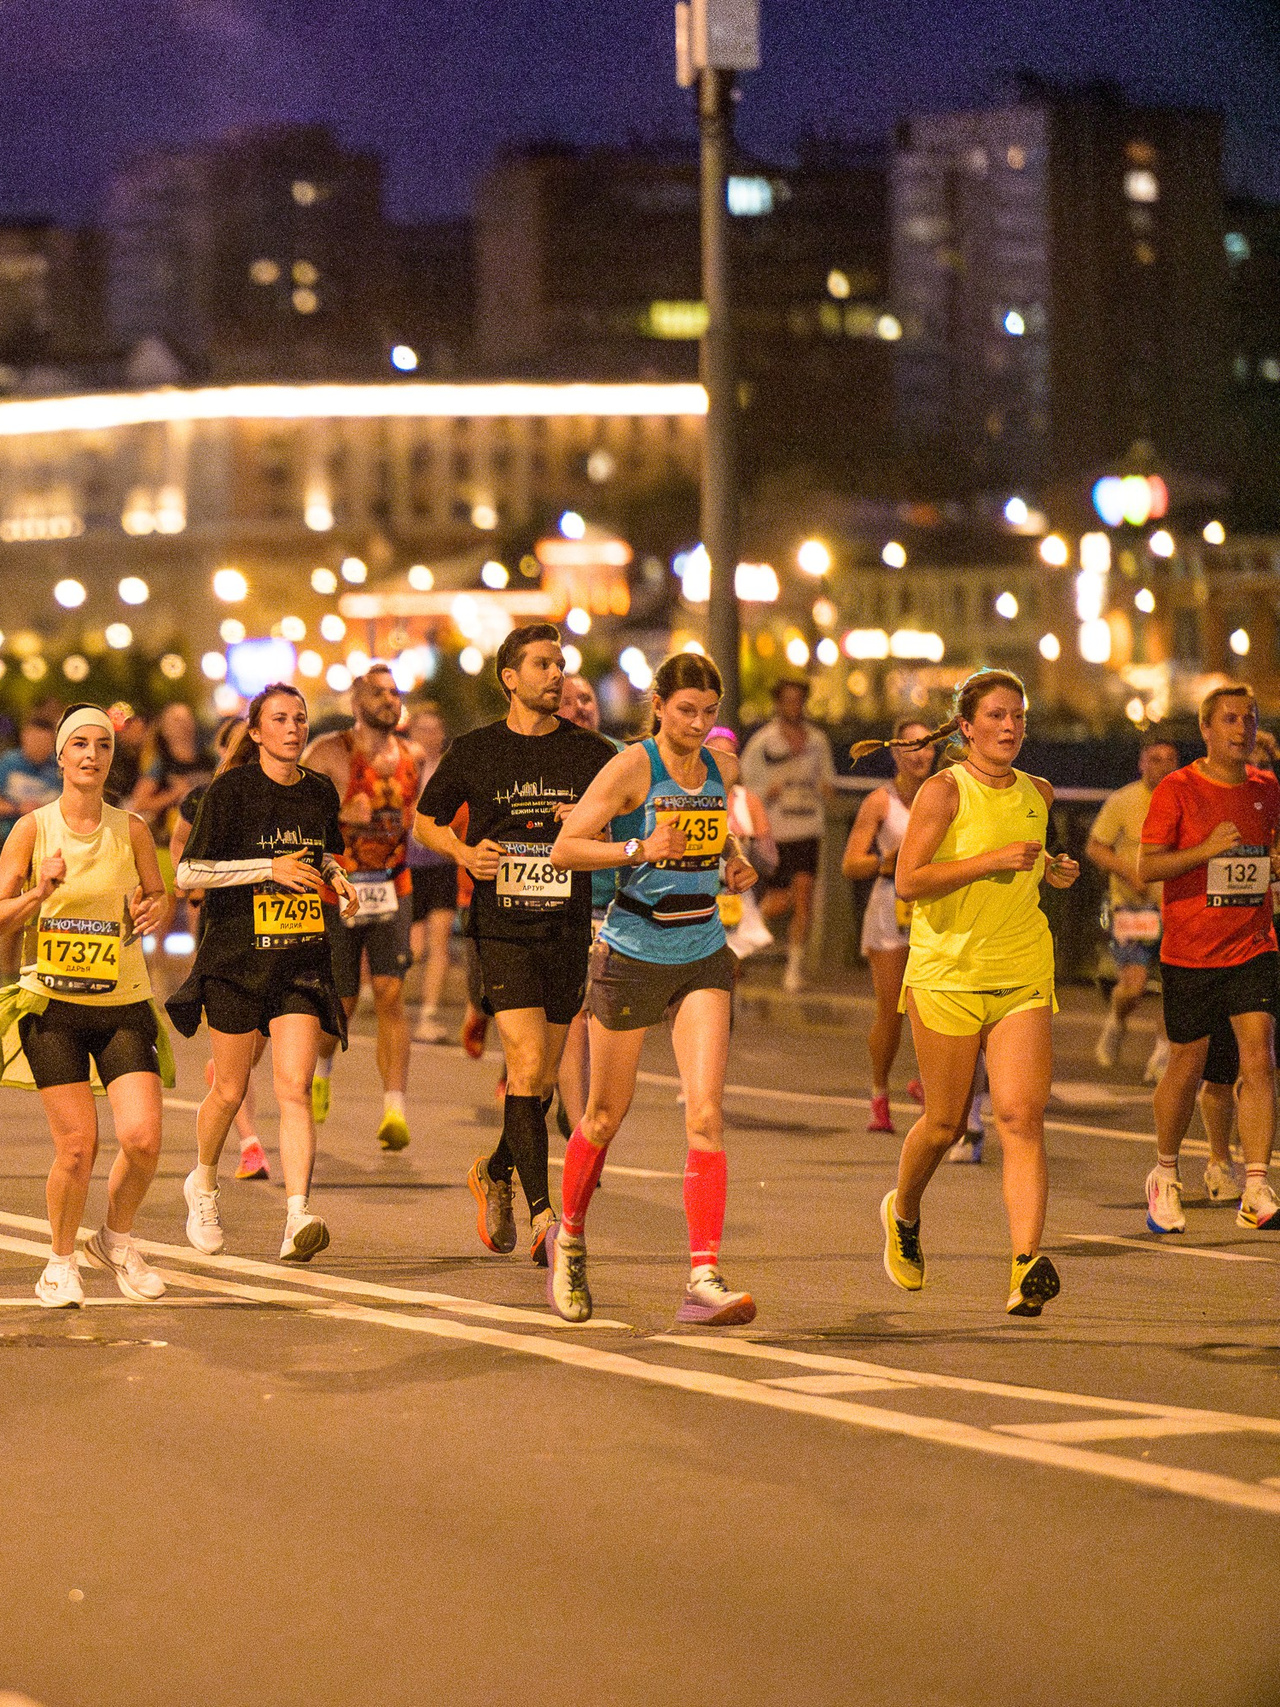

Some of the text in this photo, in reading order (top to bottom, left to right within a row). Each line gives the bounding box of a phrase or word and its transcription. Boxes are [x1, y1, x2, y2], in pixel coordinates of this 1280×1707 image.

[676, 817, 720, 841] 435
[506, 842, 554, 855] НОЧНО
[500, 862, 568, 884] 17488
[1224, 863, 1257, 882] 132
[503, 897, 512, 908] B
[1213, 896, 1222, 907] D
[258, 899, 321, 922] 17495
[280, 922, 303, 930] ЛИДИЯ
[262, 936, 271, 948] B
[42, 939, 117, 966] 17374
[65, 964, 91, 972] ДАРЬЯ
